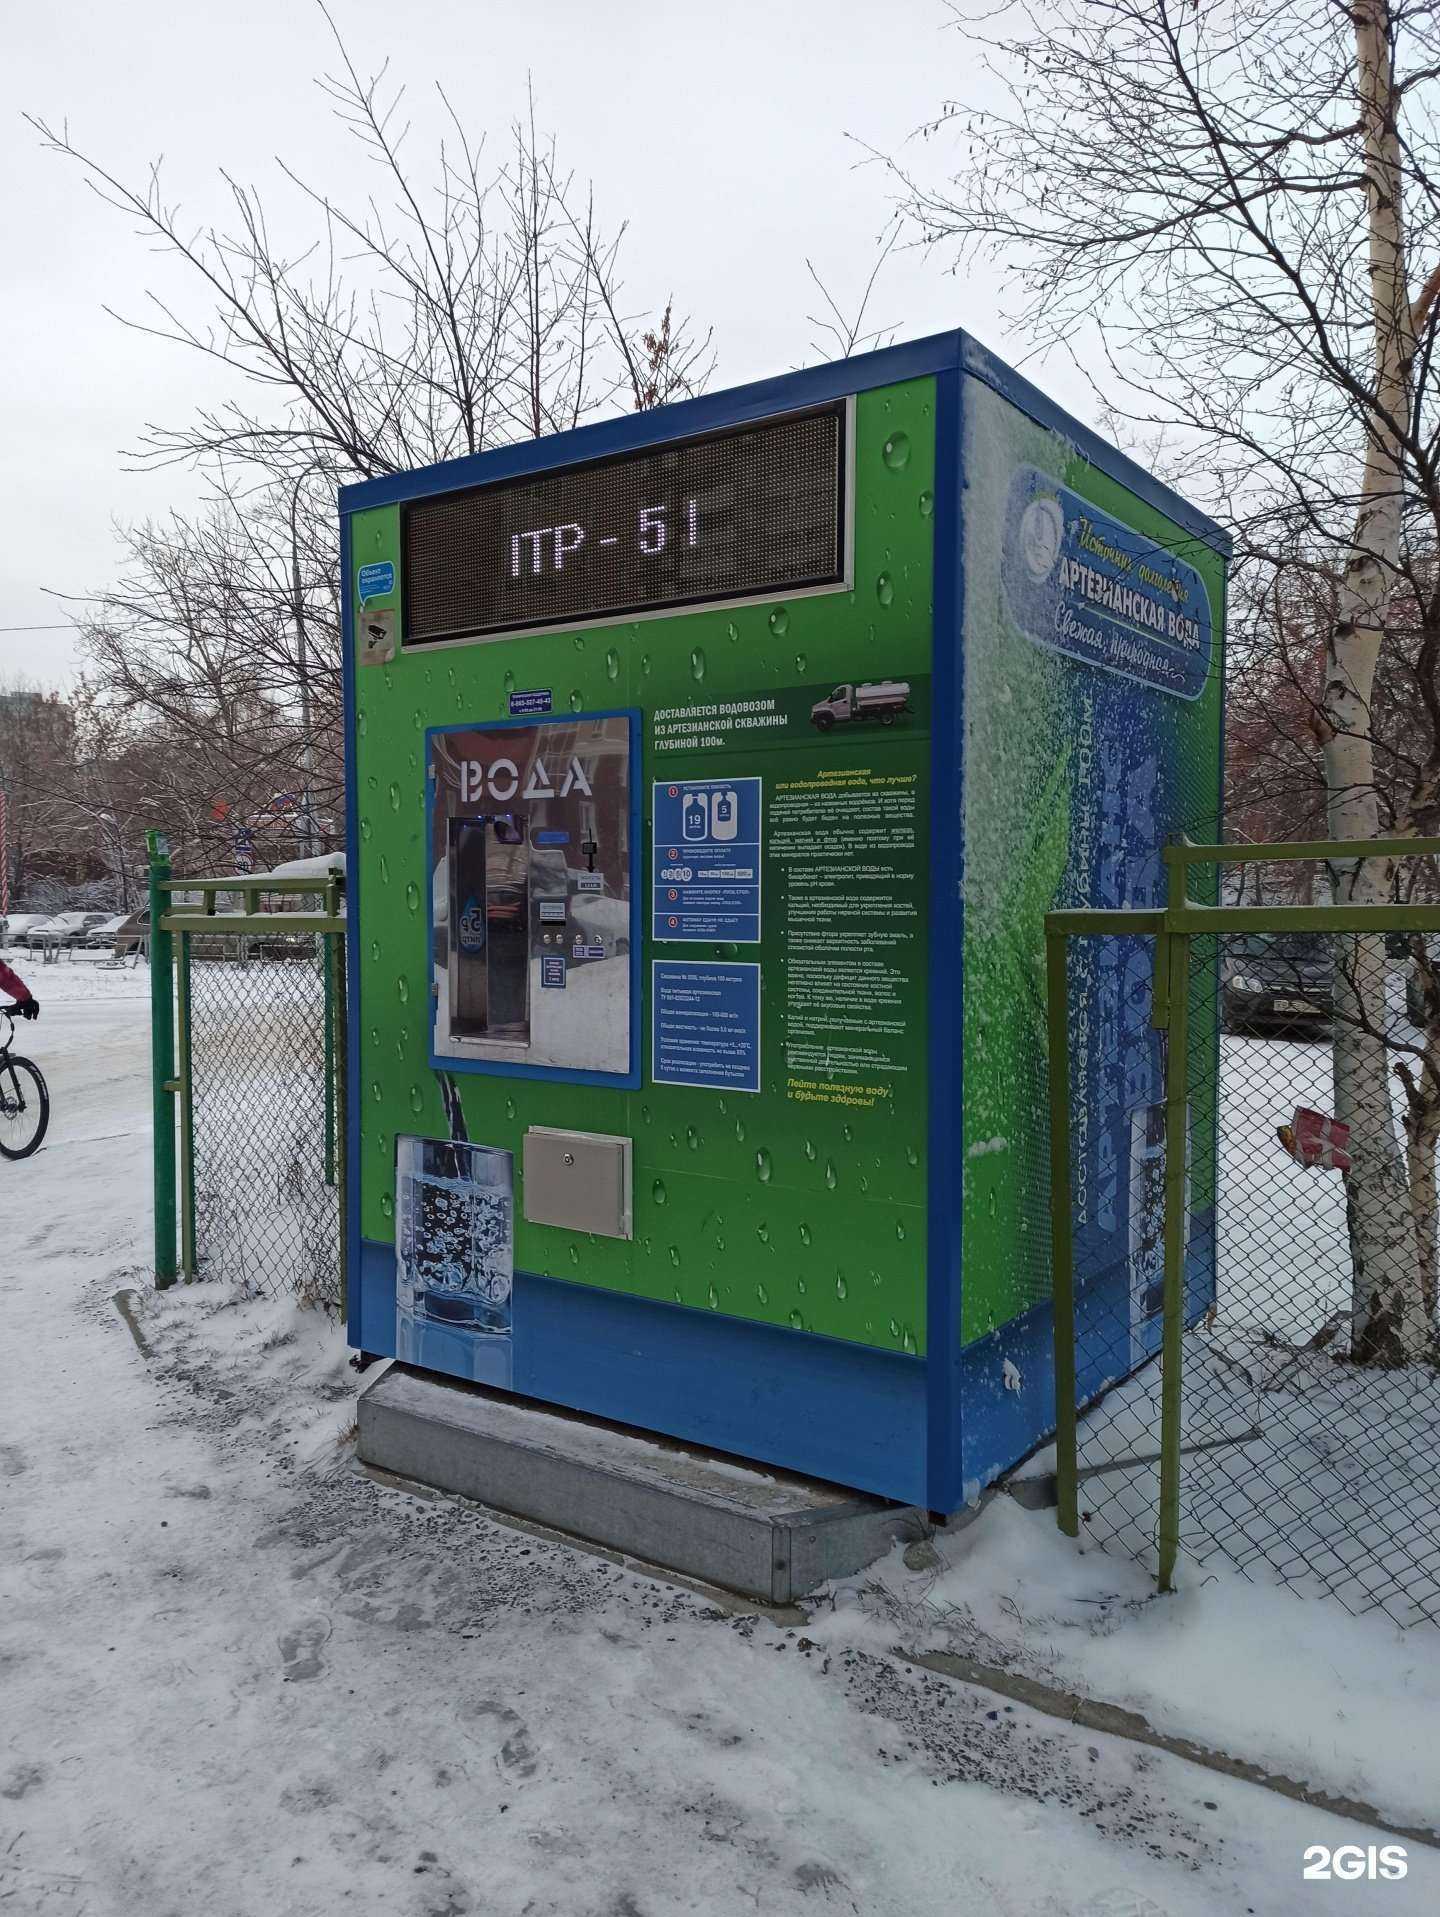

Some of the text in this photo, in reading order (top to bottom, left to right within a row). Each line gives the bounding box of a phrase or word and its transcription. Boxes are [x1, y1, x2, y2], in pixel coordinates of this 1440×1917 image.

[1059, 556, 1165, 632] АРТЕЗИАНСКАЯ
[654, 699, 775, 722] ДОСТАВЛЯЕТСЯ ВОДОВОЗОМ
[654, 714, 788, 736] ИЗ АРТЕЗИАНСКОЙ СКВАЖИНЫ
[654, 735, 699, 751] ГЛУБИНОЙ
[460, 756, 593, 803] ВОДА
[689, 814, 701, 825] 19
[721, 805, 727, 814] 5
